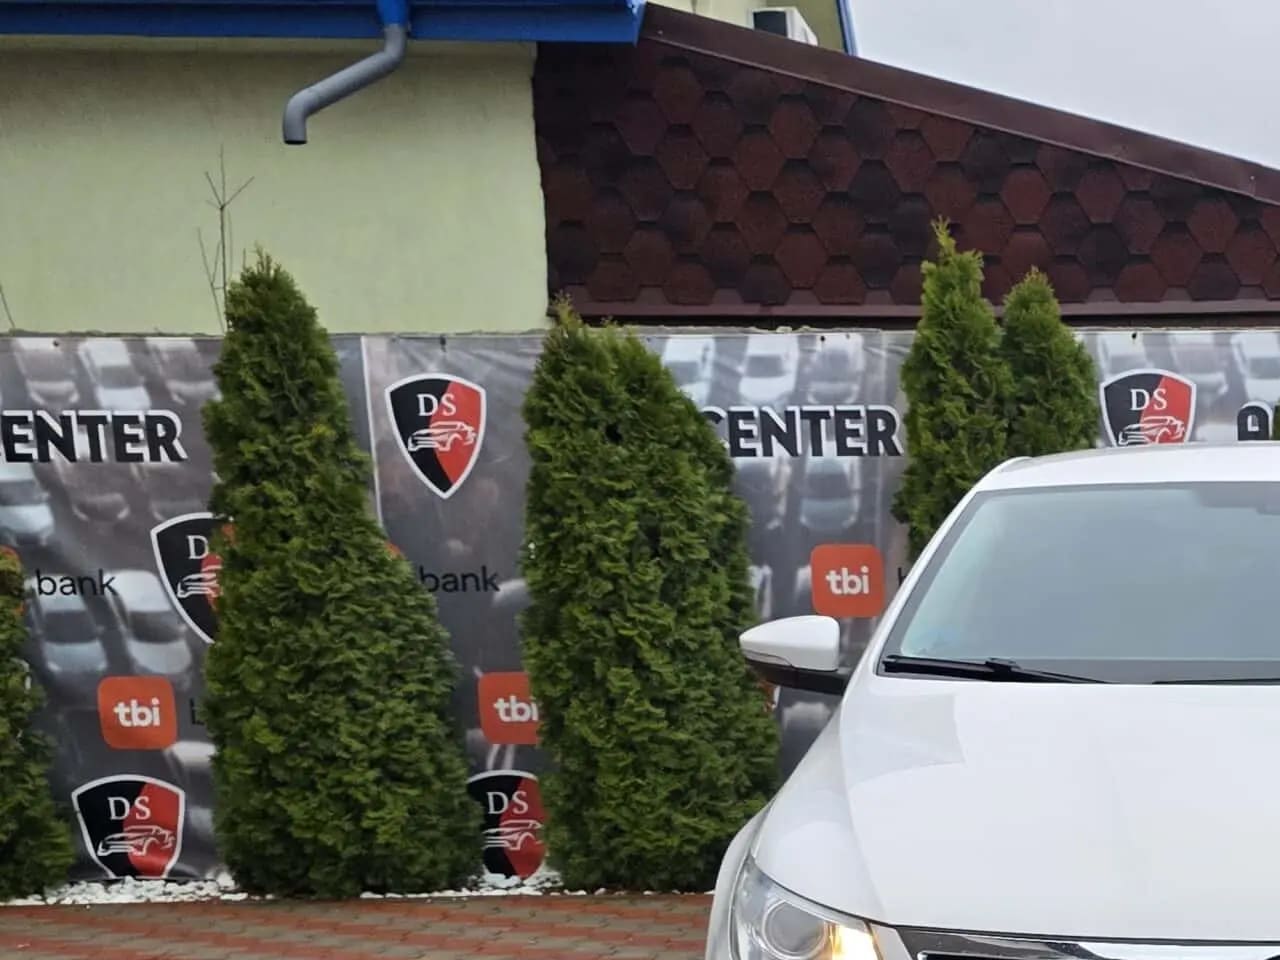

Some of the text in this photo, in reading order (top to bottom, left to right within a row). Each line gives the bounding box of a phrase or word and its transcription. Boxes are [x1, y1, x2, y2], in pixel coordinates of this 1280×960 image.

[416, 393, 457, 417] DS
[1130, 388, 1168, 411] DS
[0, 409, 188, 463] ENTER
[186, 535, 210, 560] D
[36, 568, 117, 597] bank
[419, 565, 500, 593] bank
[825, 565, 870, 595] tbi
[113, 696, 161, 728] tbi
[107, 796, 152, 821] DS
[487, 790, 530, 815] DS
